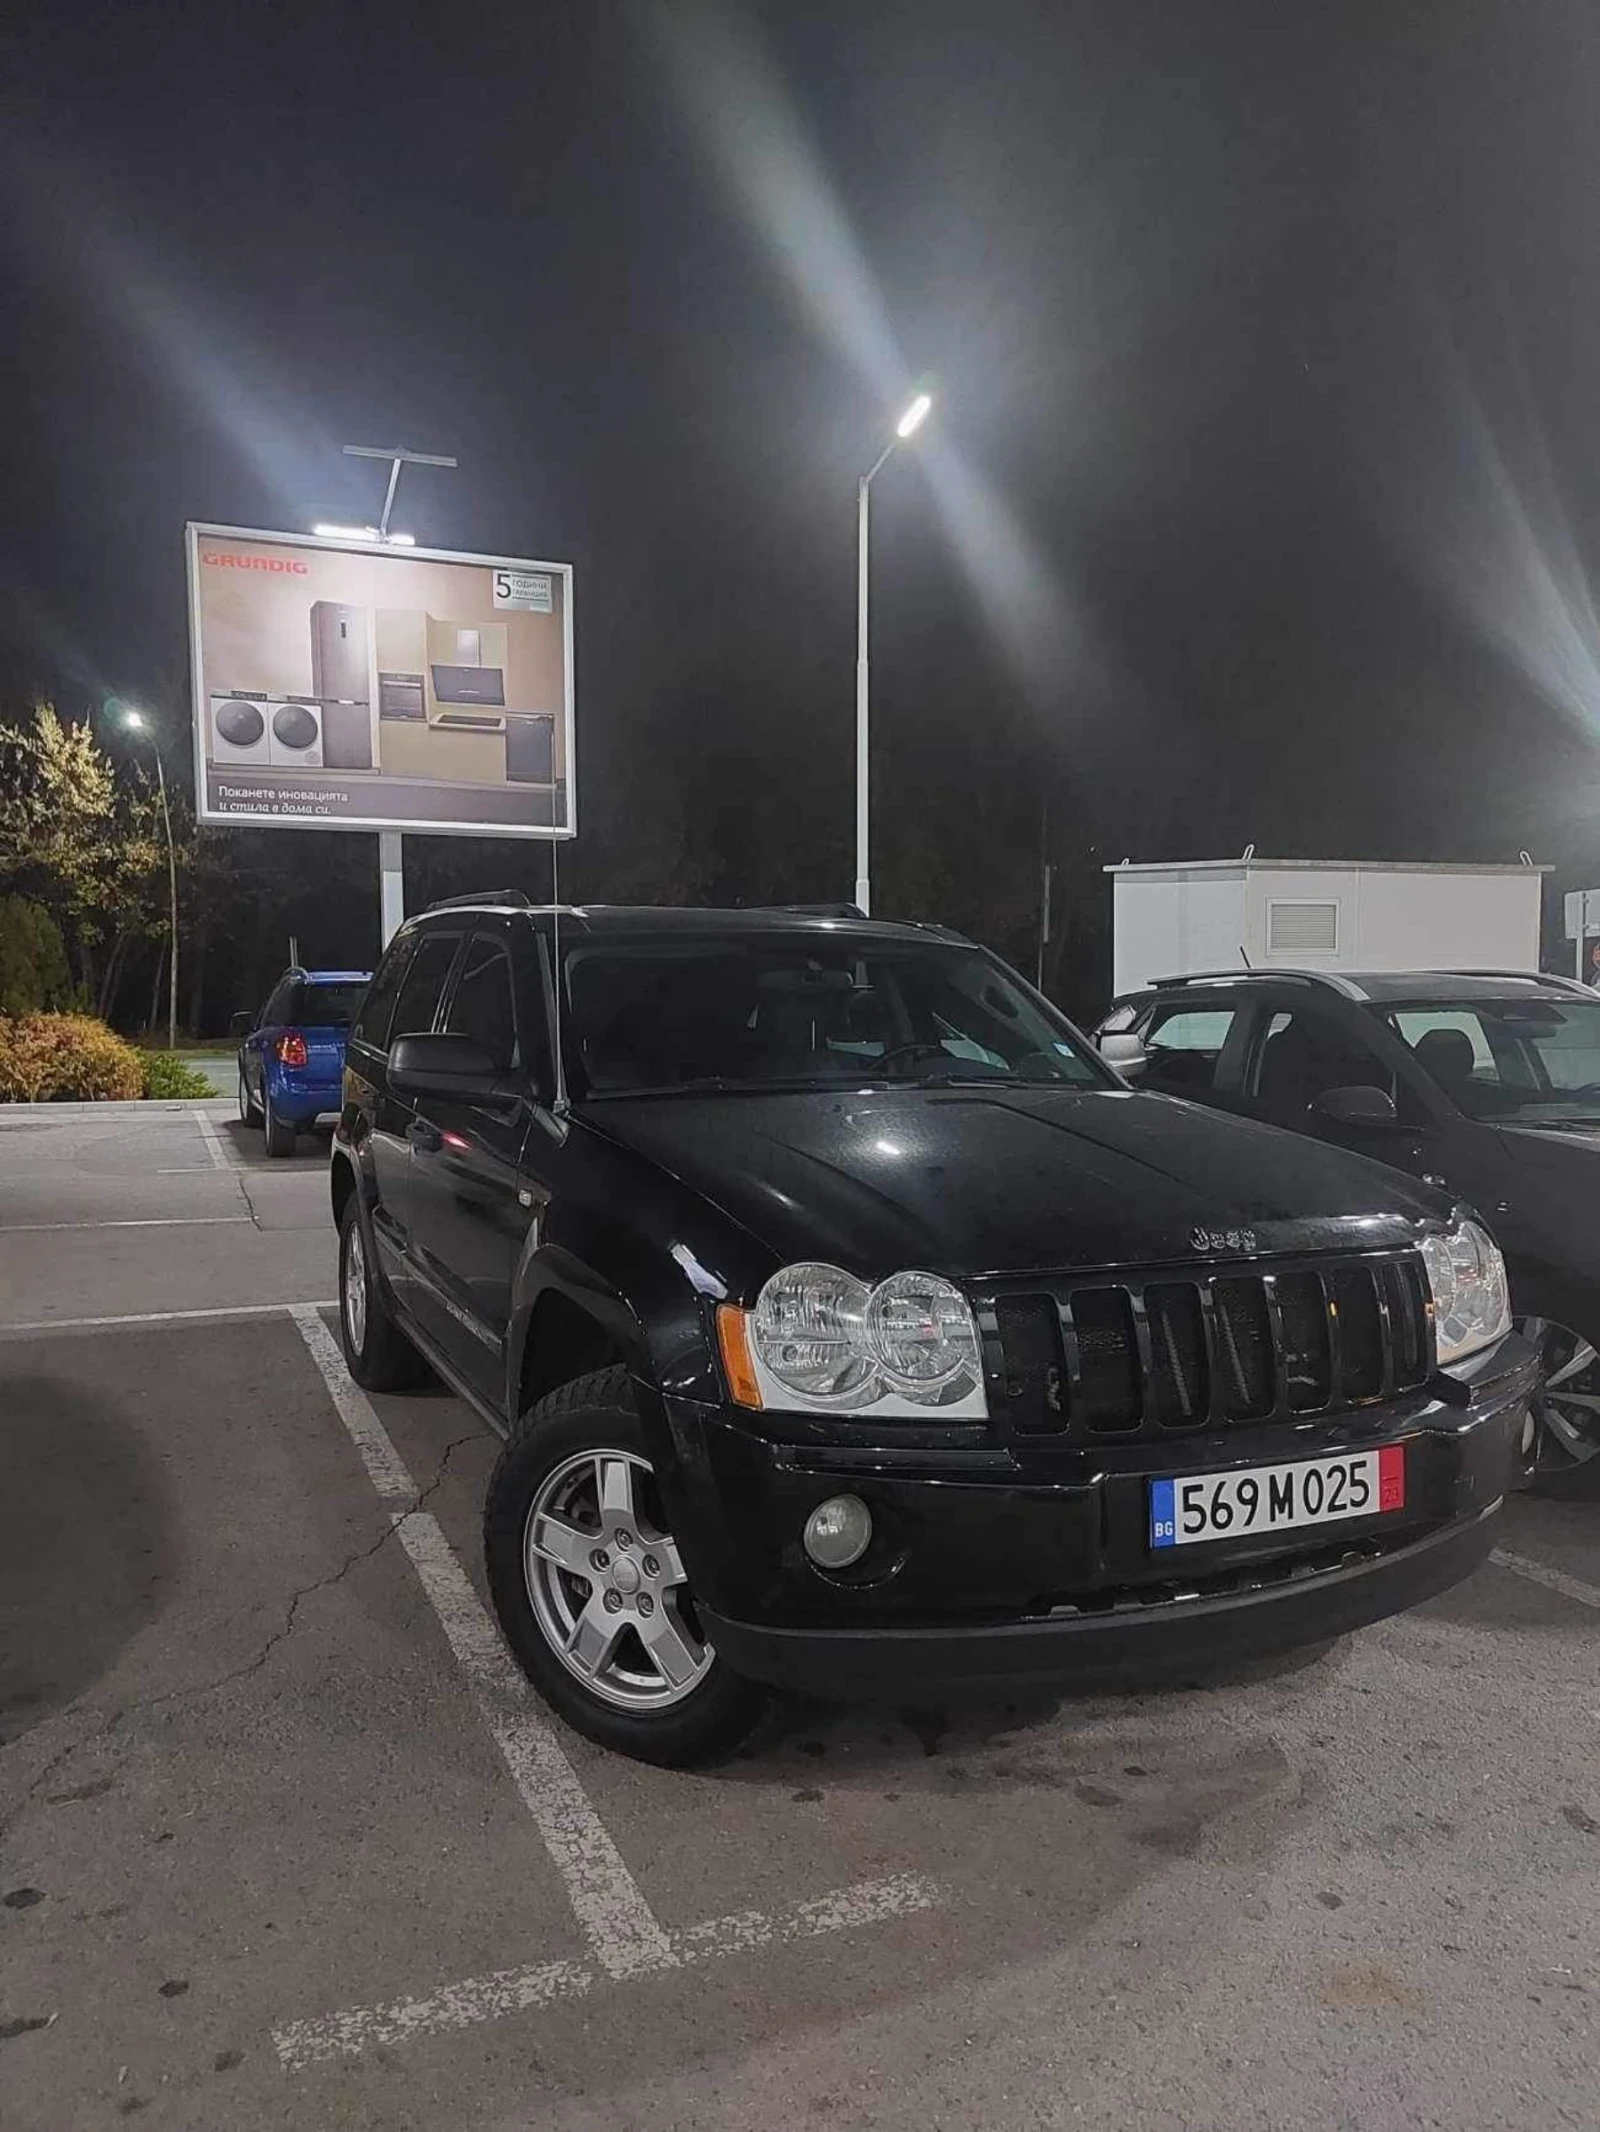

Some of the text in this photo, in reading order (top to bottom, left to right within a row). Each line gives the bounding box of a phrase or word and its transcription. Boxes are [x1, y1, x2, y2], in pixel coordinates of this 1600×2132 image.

[203, 552, 309, 574] GRUNDIG
[496, 573, 511, 598] 5
[218, 785, 348, 802] Поканете иновацията
[230, 802, 269, 812] стила
[281, 802, 312, 814] дома
[1190, 1227, 1256, 1251] Jeep
[1182, 1478, 1259, 1535] 569
[1303, 1460, 1370, 1516] 025
[1155, 1521, 1174, 1538] BG
